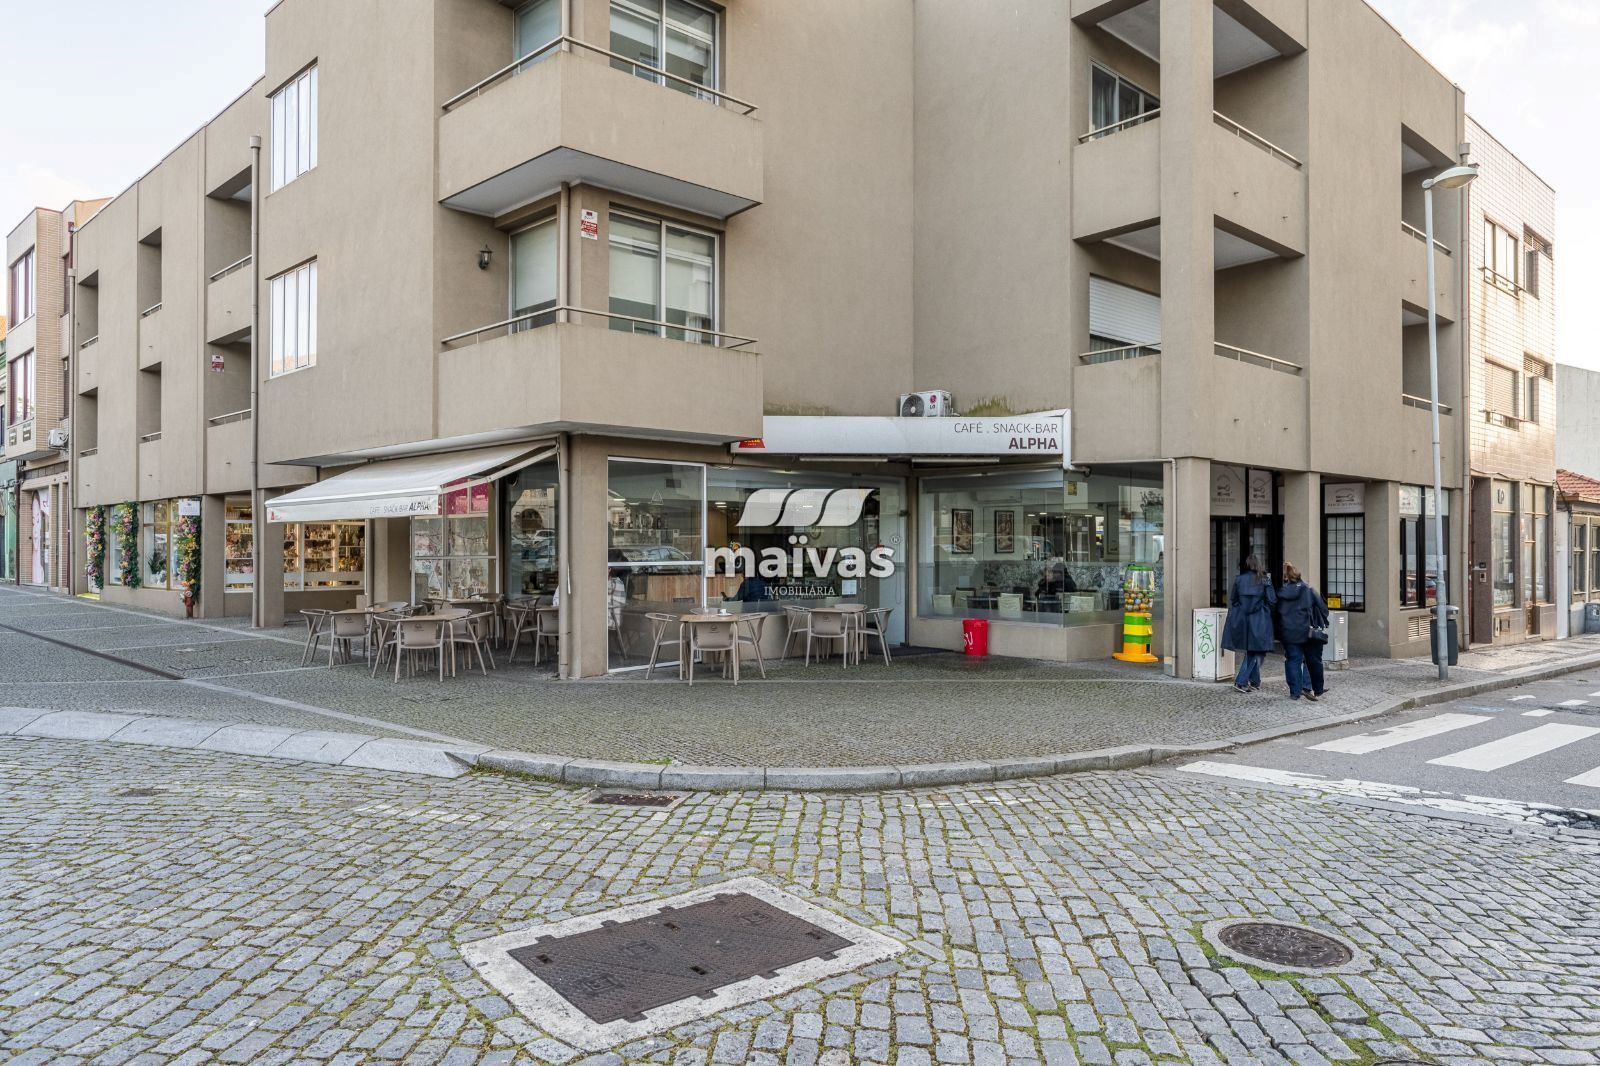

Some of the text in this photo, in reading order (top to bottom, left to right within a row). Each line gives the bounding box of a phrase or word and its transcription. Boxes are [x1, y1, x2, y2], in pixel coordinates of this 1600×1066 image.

[954, 421, 983, 434] CAFÉ
[993, 423, 1058, 434] SNACK-BAR
[1008, 437, 1058, 450] ALPHA
[409, 501, 429, 511] ALPHA
